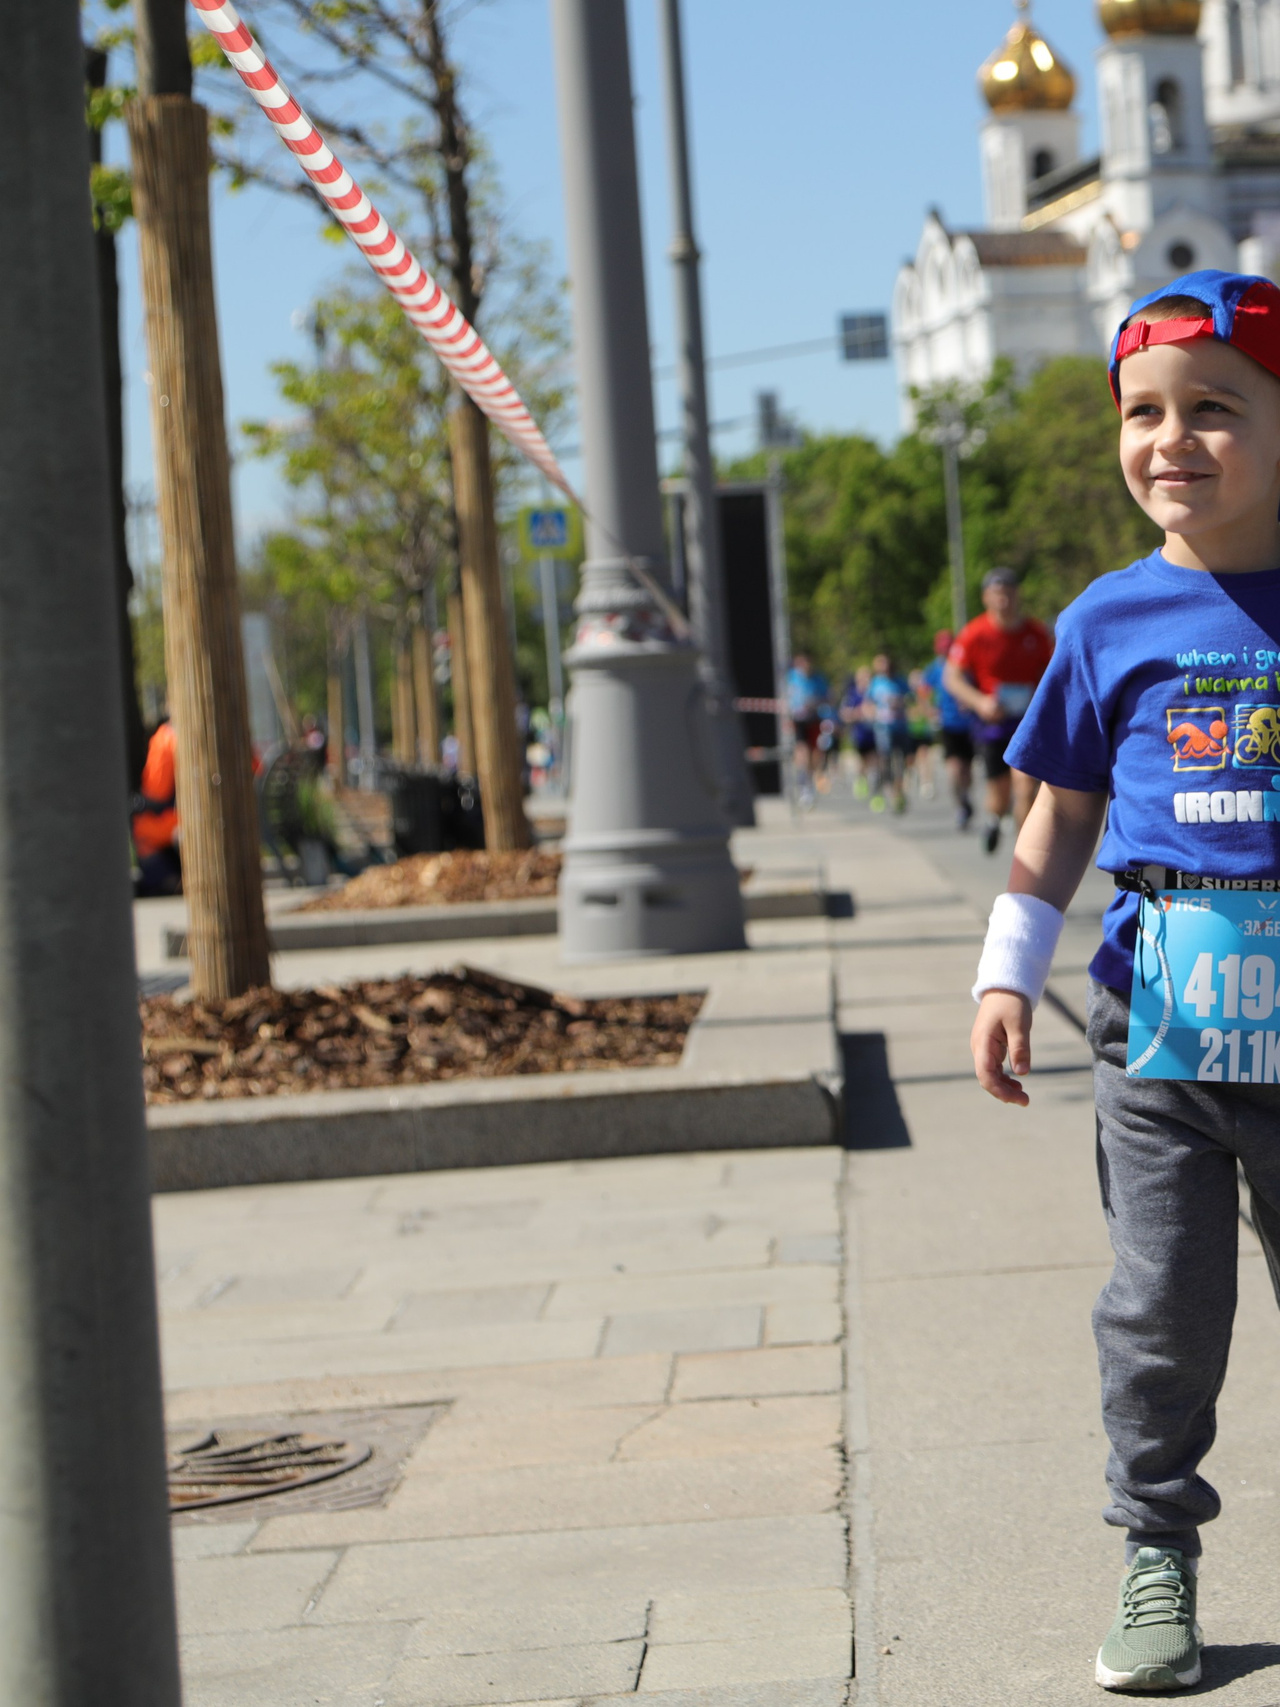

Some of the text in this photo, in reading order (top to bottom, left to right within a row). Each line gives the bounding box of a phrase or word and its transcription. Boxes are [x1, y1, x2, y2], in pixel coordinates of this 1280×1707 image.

[1176, 648, 1236, 668] when
[1243, 646, 1249, 665] i
[1183, 673, 1190, 696] i
[1195, 675, 1269, 694] wanna
[1175, 897, 1212, 913] ПСБ
